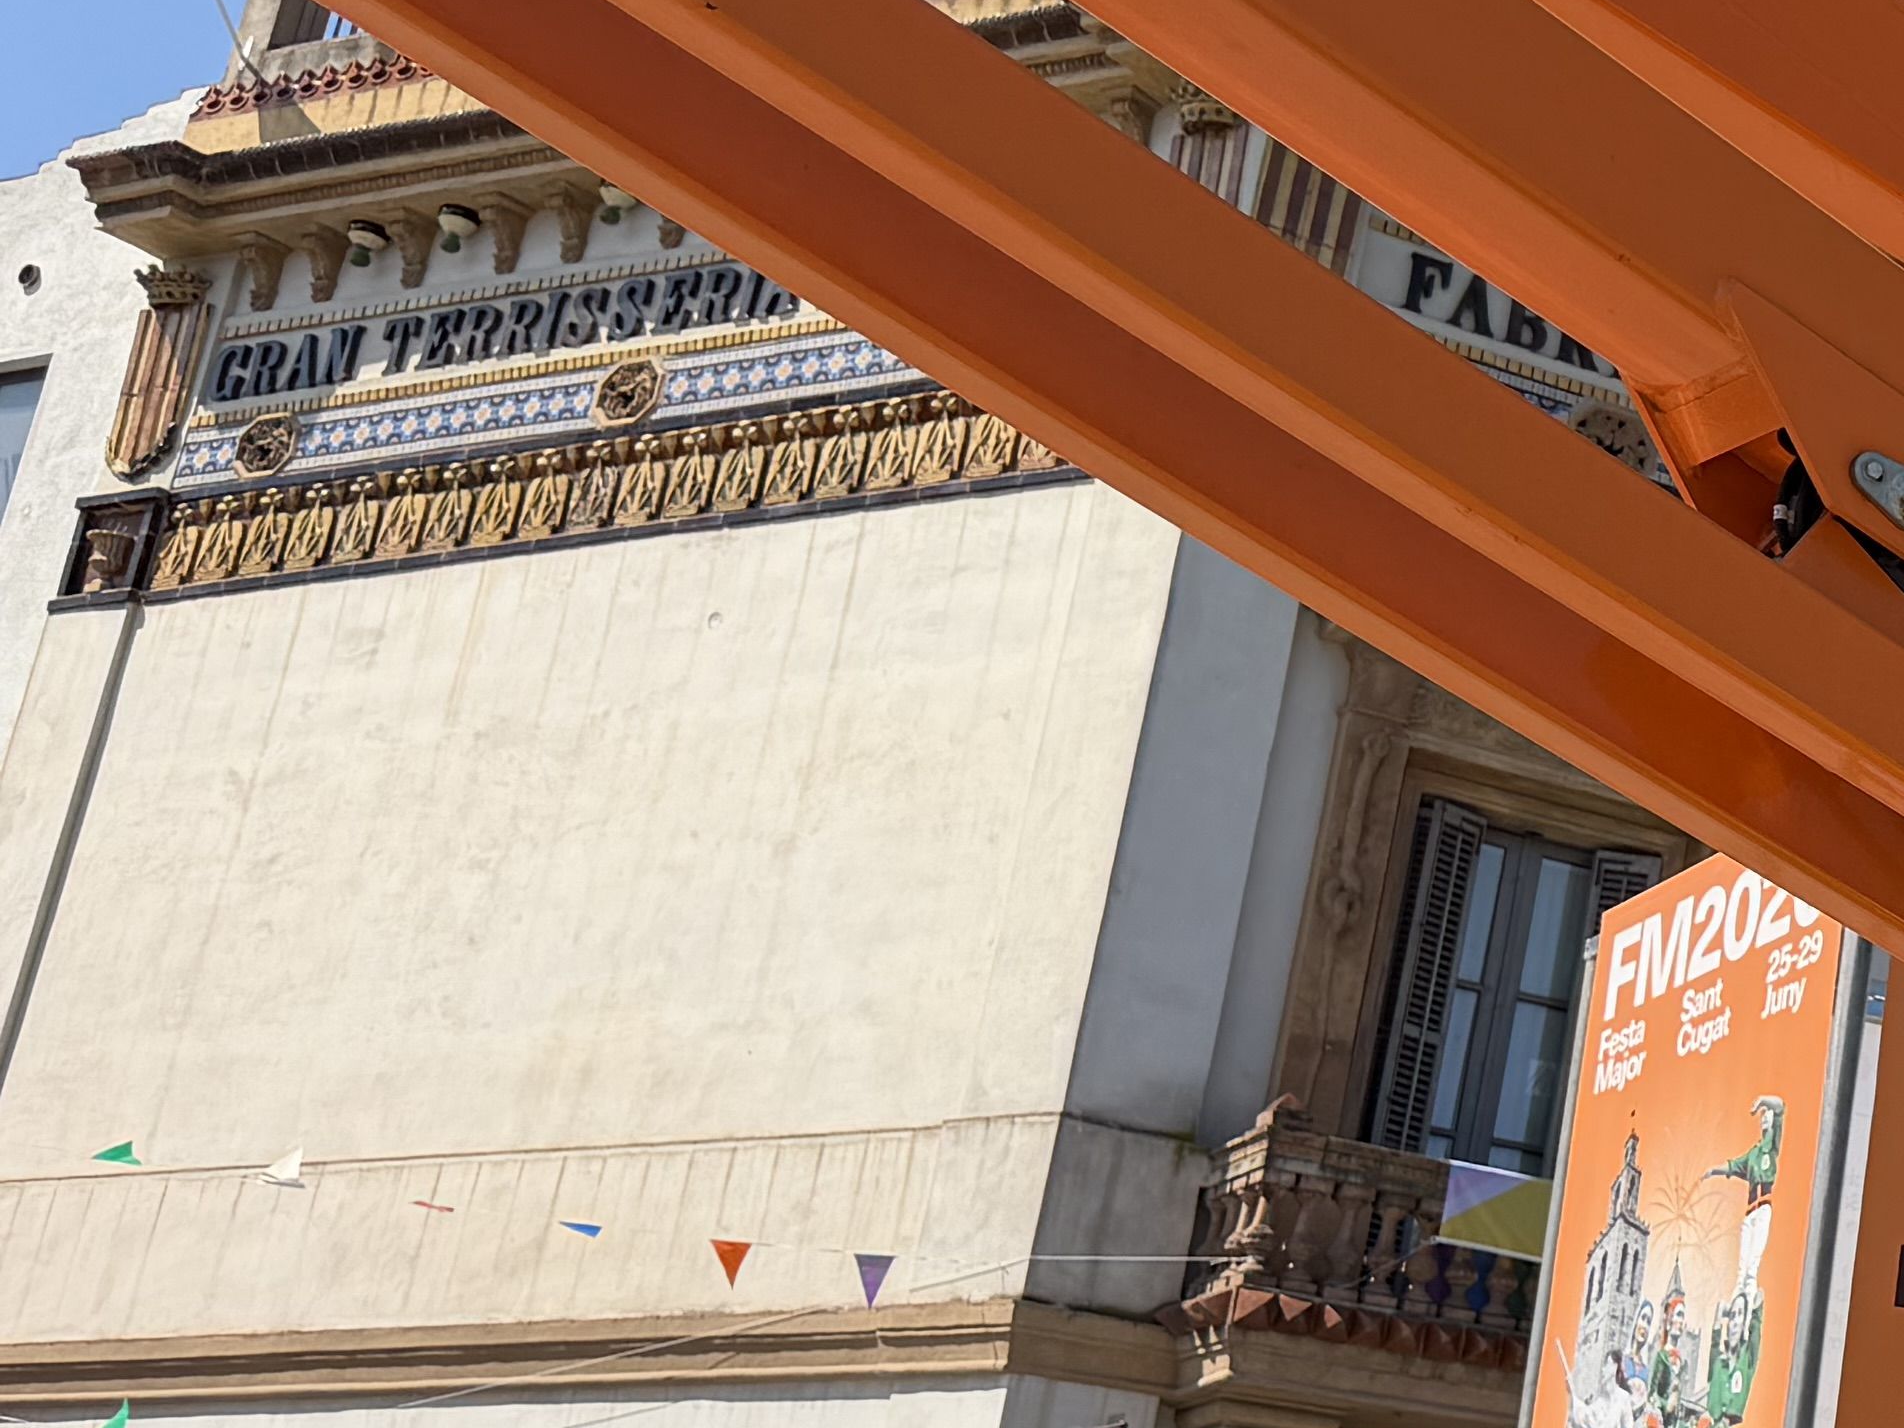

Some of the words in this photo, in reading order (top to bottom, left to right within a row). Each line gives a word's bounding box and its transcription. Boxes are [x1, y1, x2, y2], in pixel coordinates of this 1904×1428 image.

[207, 324, 367, 402] GRAN
[381, 262, 800, 374] TERRISSERIA
[1764, 929, 1824, 984] 25-29
[1680, 977, 1723, 1022] Sant
[1761, 977, 1807, 1020] Juny
[1598, 1019, 1646, 1061] Festa
[1676, 1006, 1732, 1057] Cugat
[1593, 1051, 1647, 1095] Major
